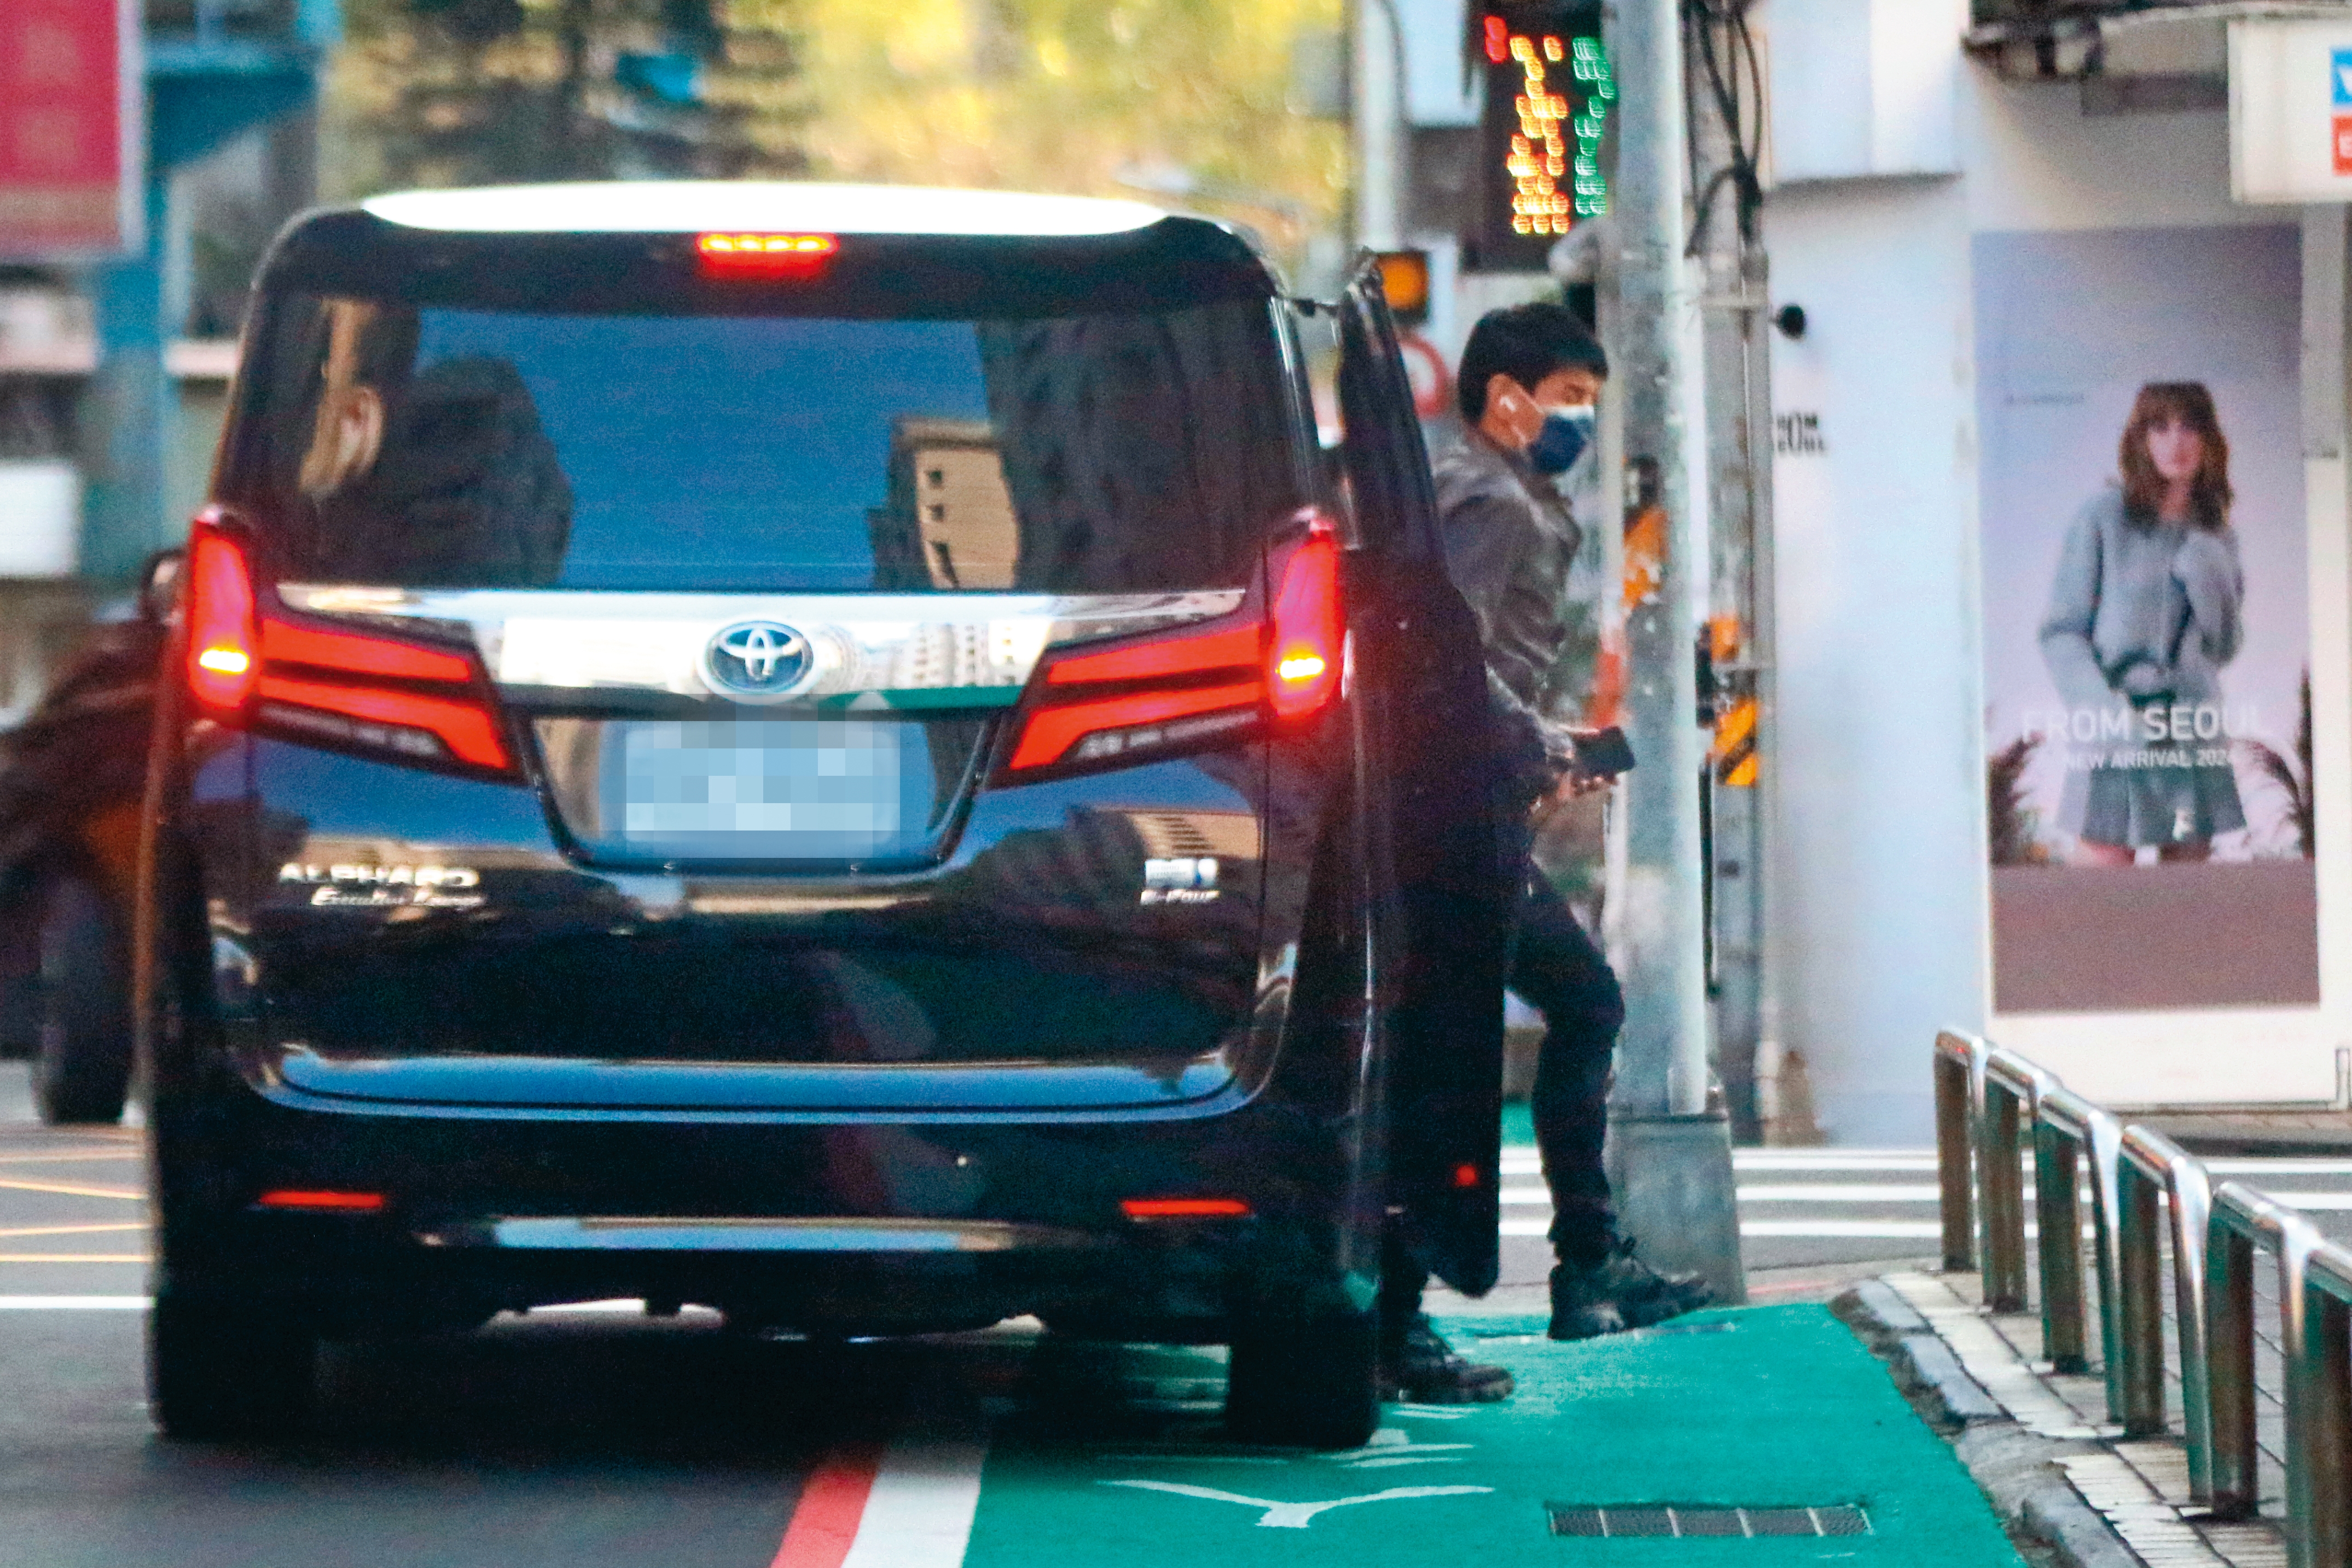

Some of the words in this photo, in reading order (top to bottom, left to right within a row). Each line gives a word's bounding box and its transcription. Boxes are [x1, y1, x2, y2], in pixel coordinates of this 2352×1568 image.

[2023, 708, 2132, 740] FROM
[2144, 705, 2266, 740] SEOUL
[2109, 750, 2192, 769] ARRIVAL
